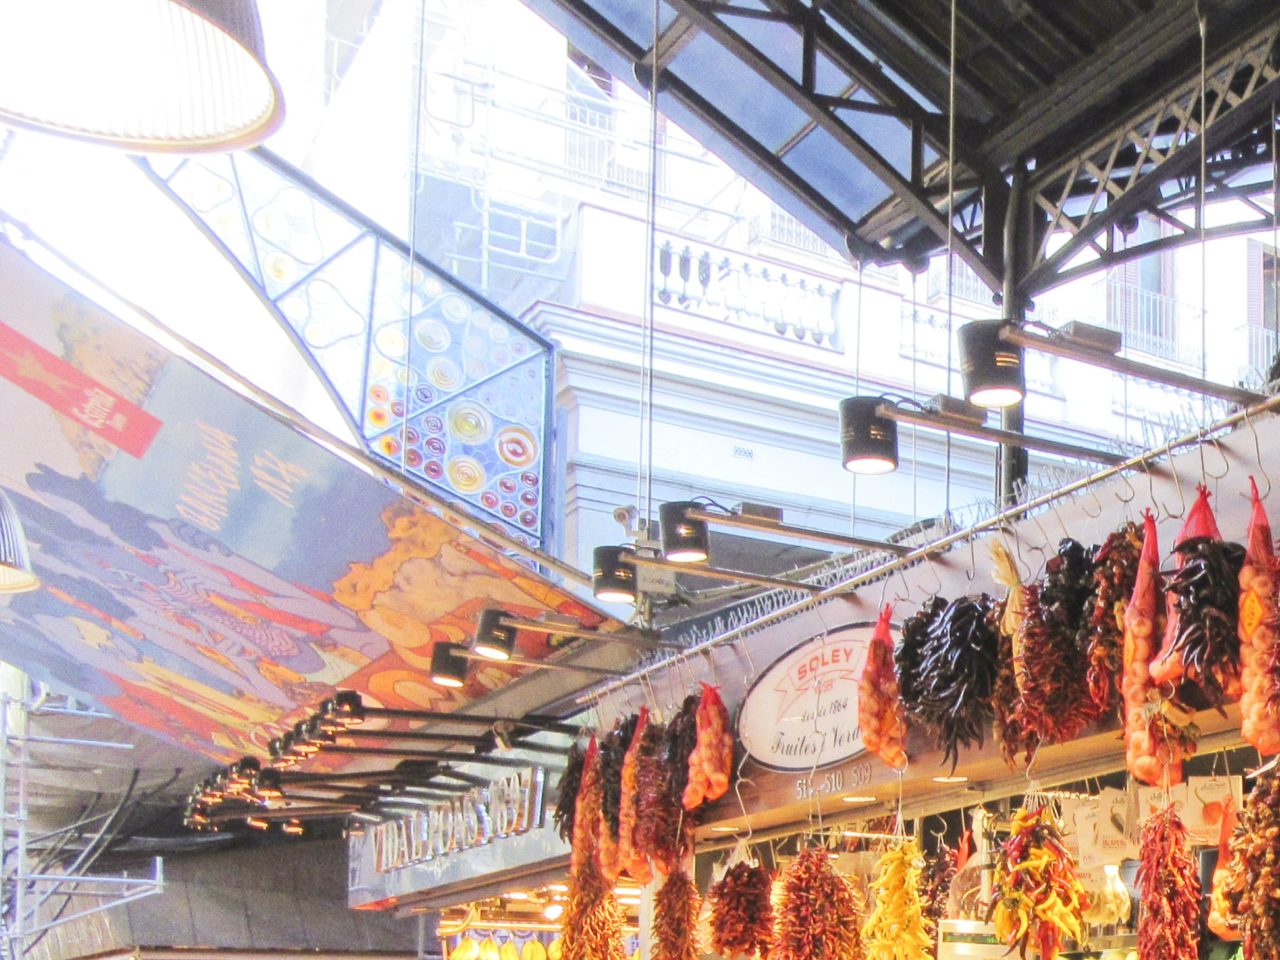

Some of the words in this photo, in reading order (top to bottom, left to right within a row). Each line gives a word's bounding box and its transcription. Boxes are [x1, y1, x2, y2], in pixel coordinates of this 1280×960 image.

[175, 418, 241, 532] BARCELONA
[797, 648, 854, 681] SOLEY
[829, 698, 849, 716] 1864
[771, 730, 818, 756] Fruites
[832, 726, 862, 749] Verd
[852, 761, 873, 787] 509
